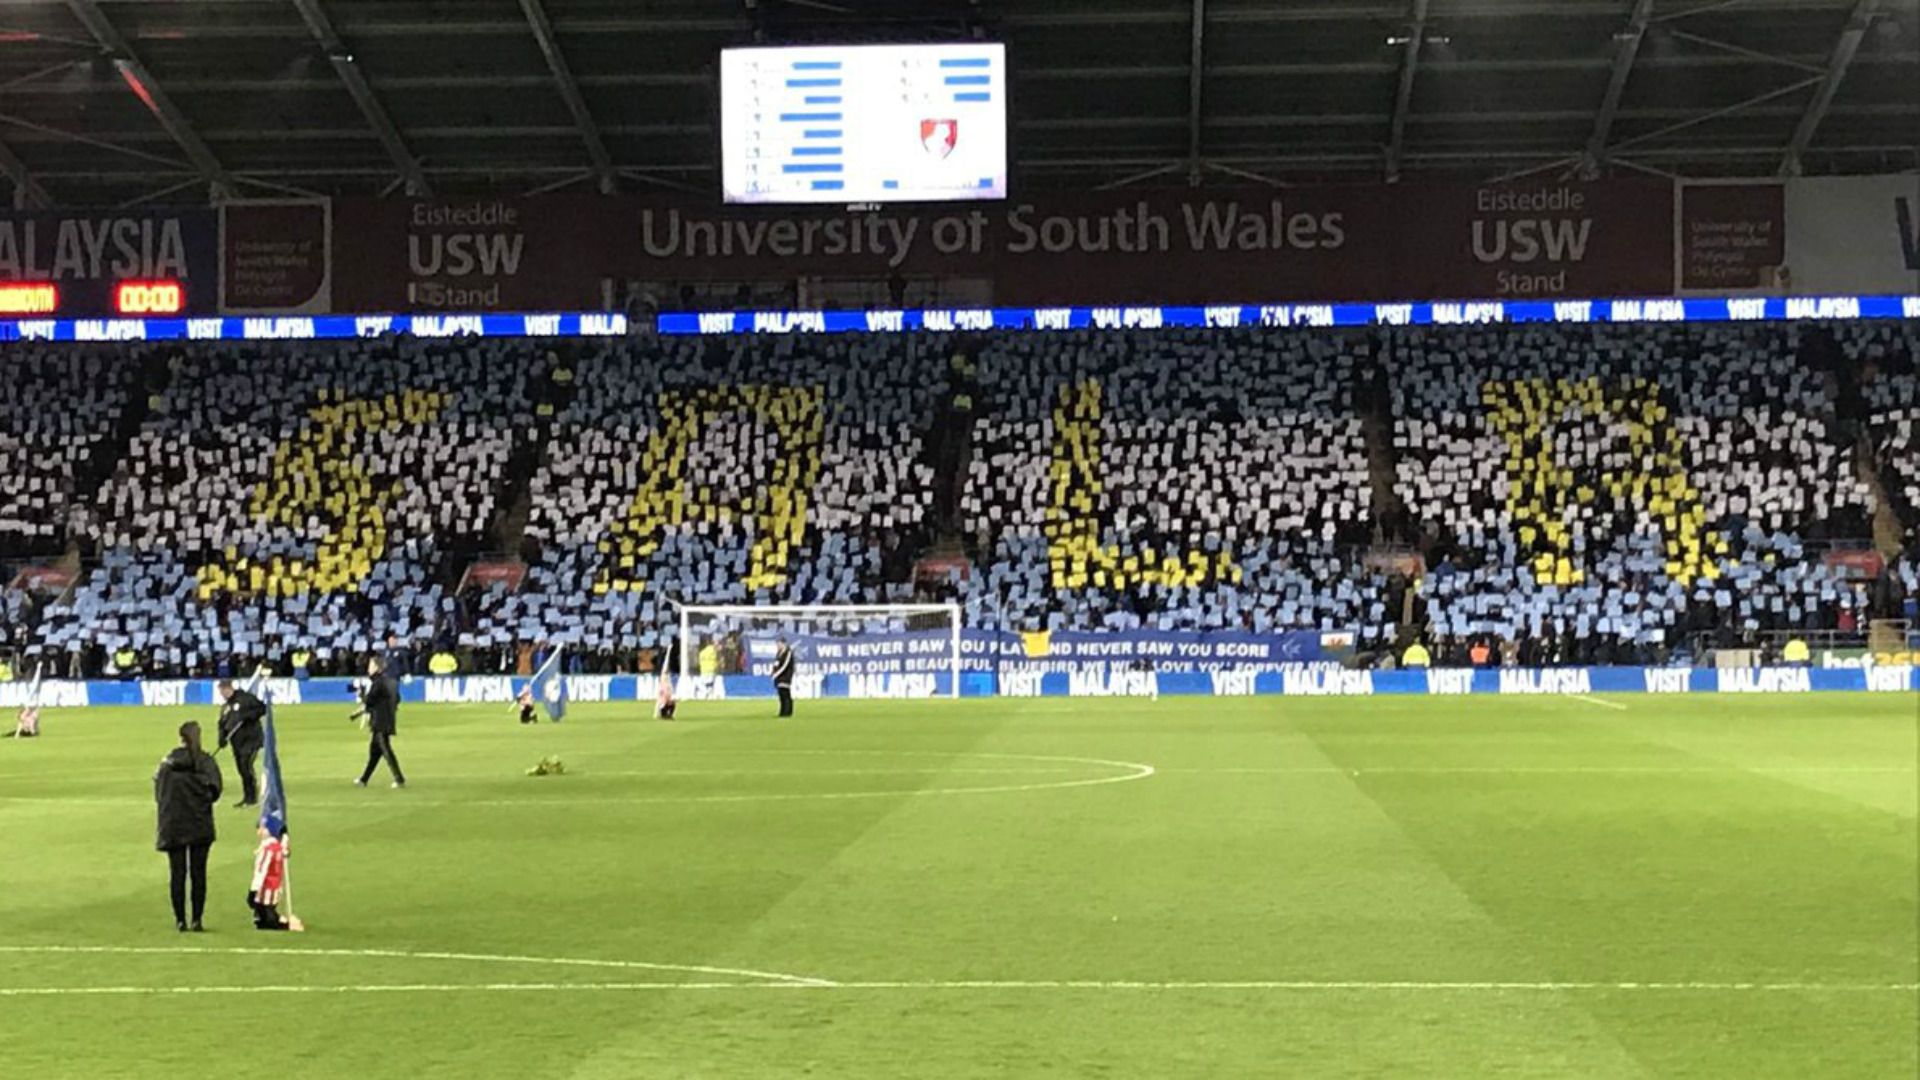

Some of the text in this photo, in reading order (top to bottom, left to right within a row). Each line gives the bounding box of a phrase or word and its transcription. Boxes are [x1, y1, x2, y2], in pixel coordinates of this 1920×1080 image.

[1477, 188, 1584, 212] Eisteddle
[411, 203, 518, 227] Eisteddle
[641, 199, 1346, 267] University of South Wales
[1472, 218, 1592, 262] USW
[408, 233, 524, 276] USW
[1496, 270, 1566, 293] Stand
[117, 283, 181, 312] 00:00
[1727, 297, 1860, 321] VISIT MALAYSIA
[699, 313, 735, 333] VISIT
[866, 311, 904, 331] VISIT
[1034, 309, 1071, 329] VISIT
[1554, 299, 1685, 323] VISIT MALAYSIA
[75, 319, 147, 341] MALAYSIA
[187, 317, 315, 340] VISIT MALAYSIA
[525, 315, 561, 336] VISIT
[816, 643, 842, 658] WE
[847, 641, 902, 657] NEVER
[908, 639, 945, 653] SAW
[1076, 641, 1132, 656] NEVER
[1137, 640, 1173, 655] SAW
[1178, 643, 1212, 657] YOU
[1216, 644, 1269, 657] SCORE
[752, 662, 775, 677] BU
[795, 660, 862, 675] MILIANO
[866, 659, 901, 673] OUR
[1152, 659, 1193, 675] LOVE
[1645, 667, 1810, 692] VISIT MALAYSIA
[1865, 666, 1913, 692] VISIT
[140, 680, 188, 705] VISIT
[425, 677, 514, 703] MALAYSIA
[567, 676, 612, 702] VISIT
[848, 672, 938, 699] MALAYSIA
[999, 670, 1158, 697] VISIT MALAYSIA
[1211, 668, 1374, 696] VISIT MALAYSIA
[1427, 668, 1591, 694] VISIT MALAYSIA
